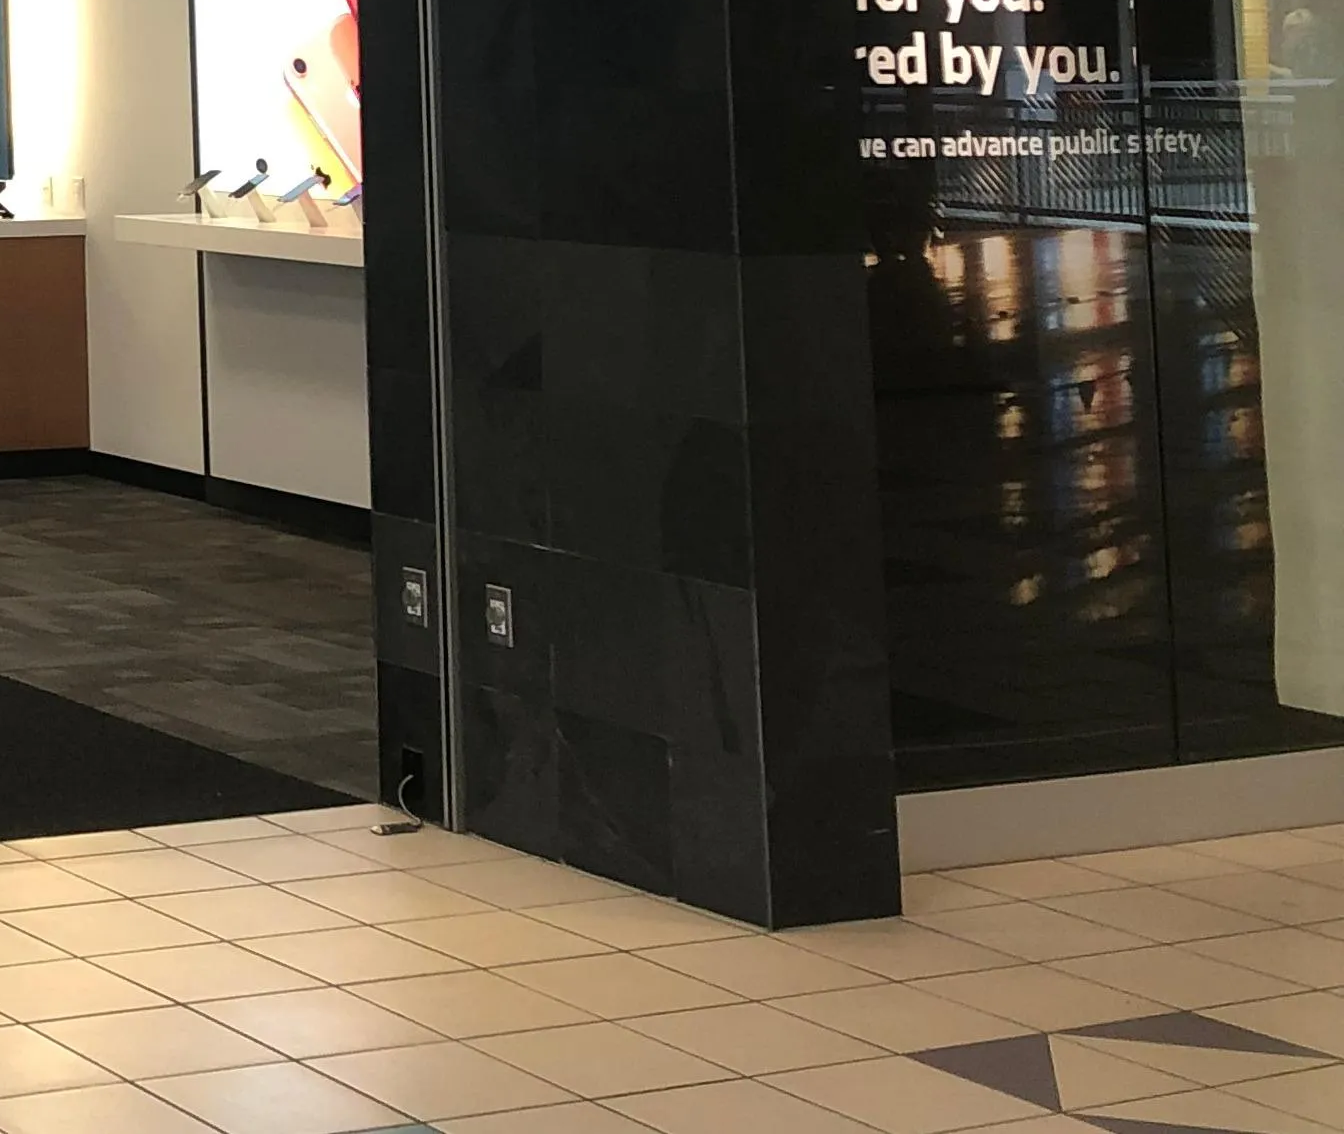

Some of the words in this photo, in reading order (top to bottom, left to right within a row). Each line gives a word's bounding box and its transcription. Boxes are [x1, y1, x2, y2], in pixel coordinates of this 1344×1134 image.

[940, 31, 1002, 96] by
[1016, 46, 1120, 96] you.
[891, 137, 937, 158] can
[941, 129, 1044, 157] advance
[1049, 128, 1122, 161] public
